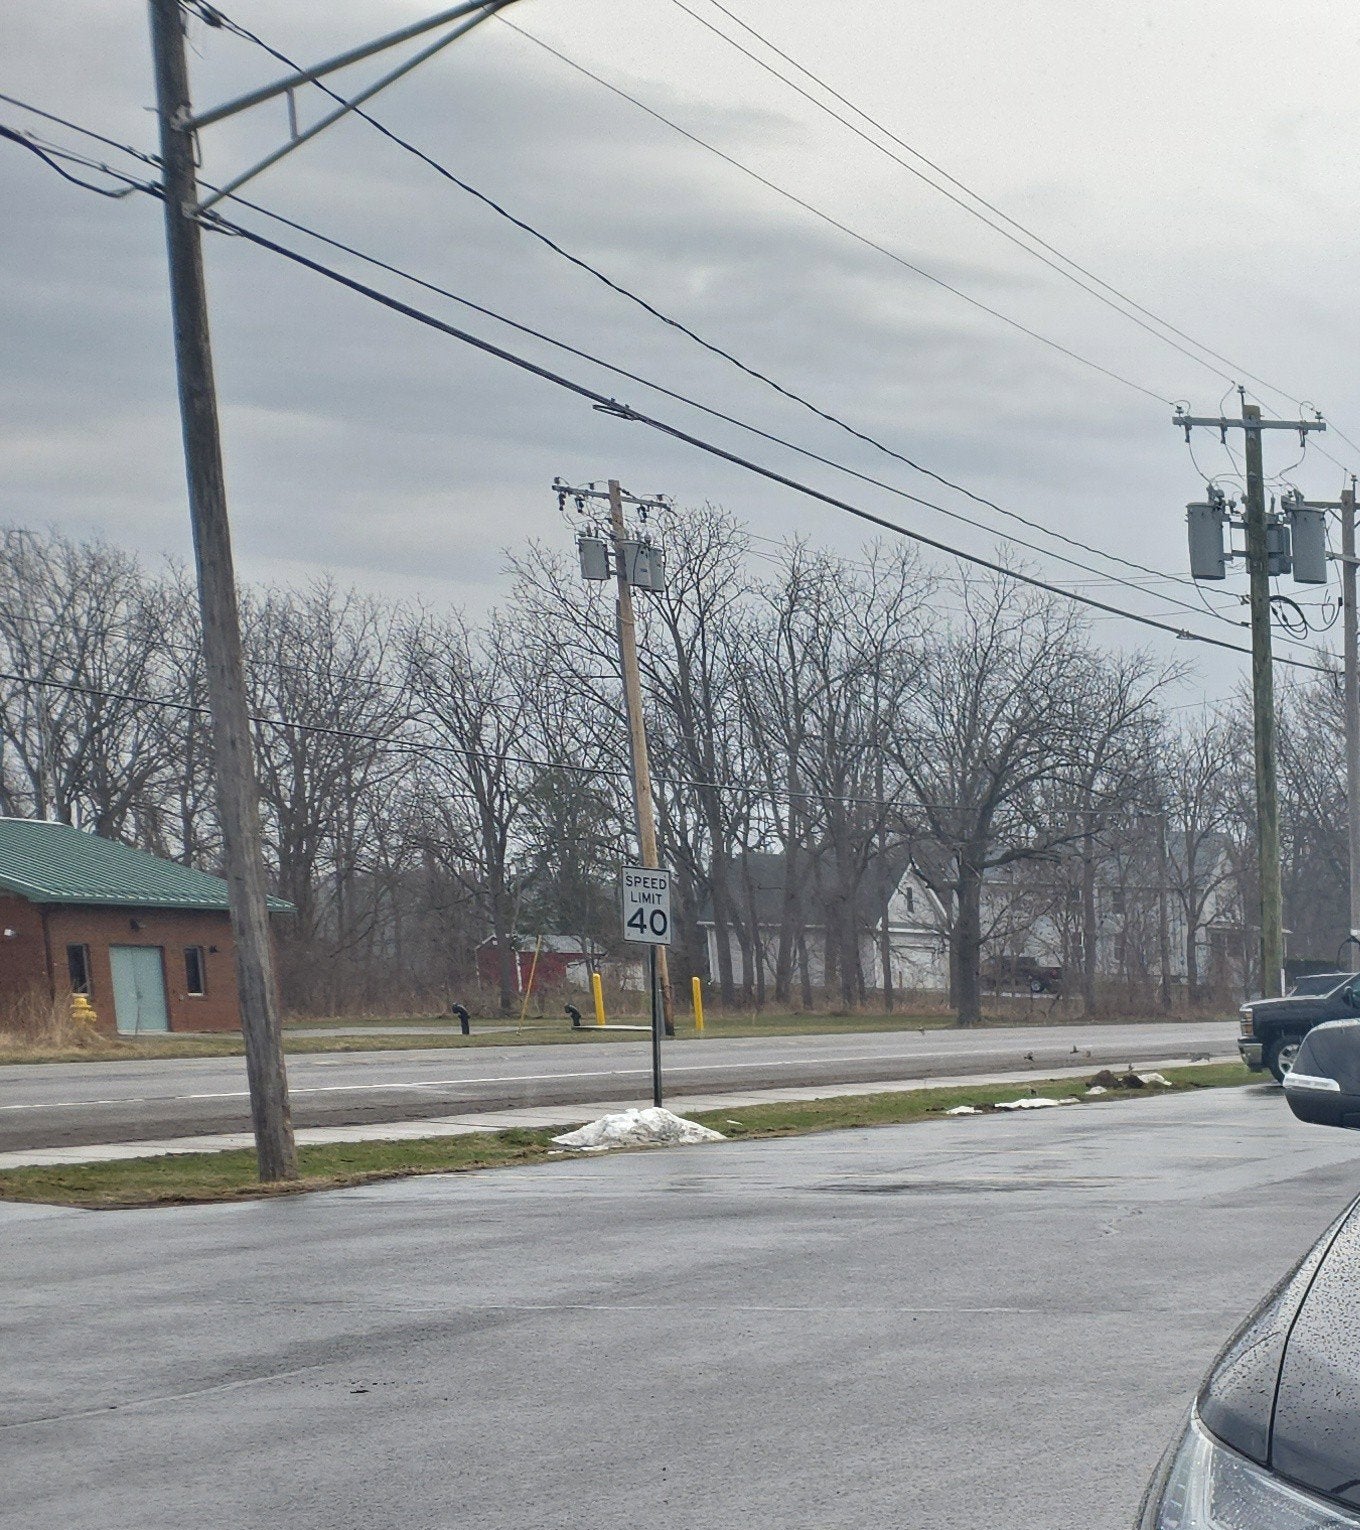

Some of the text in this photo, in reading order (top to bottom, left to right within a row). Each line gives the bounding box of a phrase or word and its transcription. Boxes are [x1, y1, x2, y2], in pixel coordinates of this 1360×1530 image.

[625, 875, 667, 890] SPEED
[630, 891, 662, 905] LIMIT
[627, 907, 668, 936] 40
